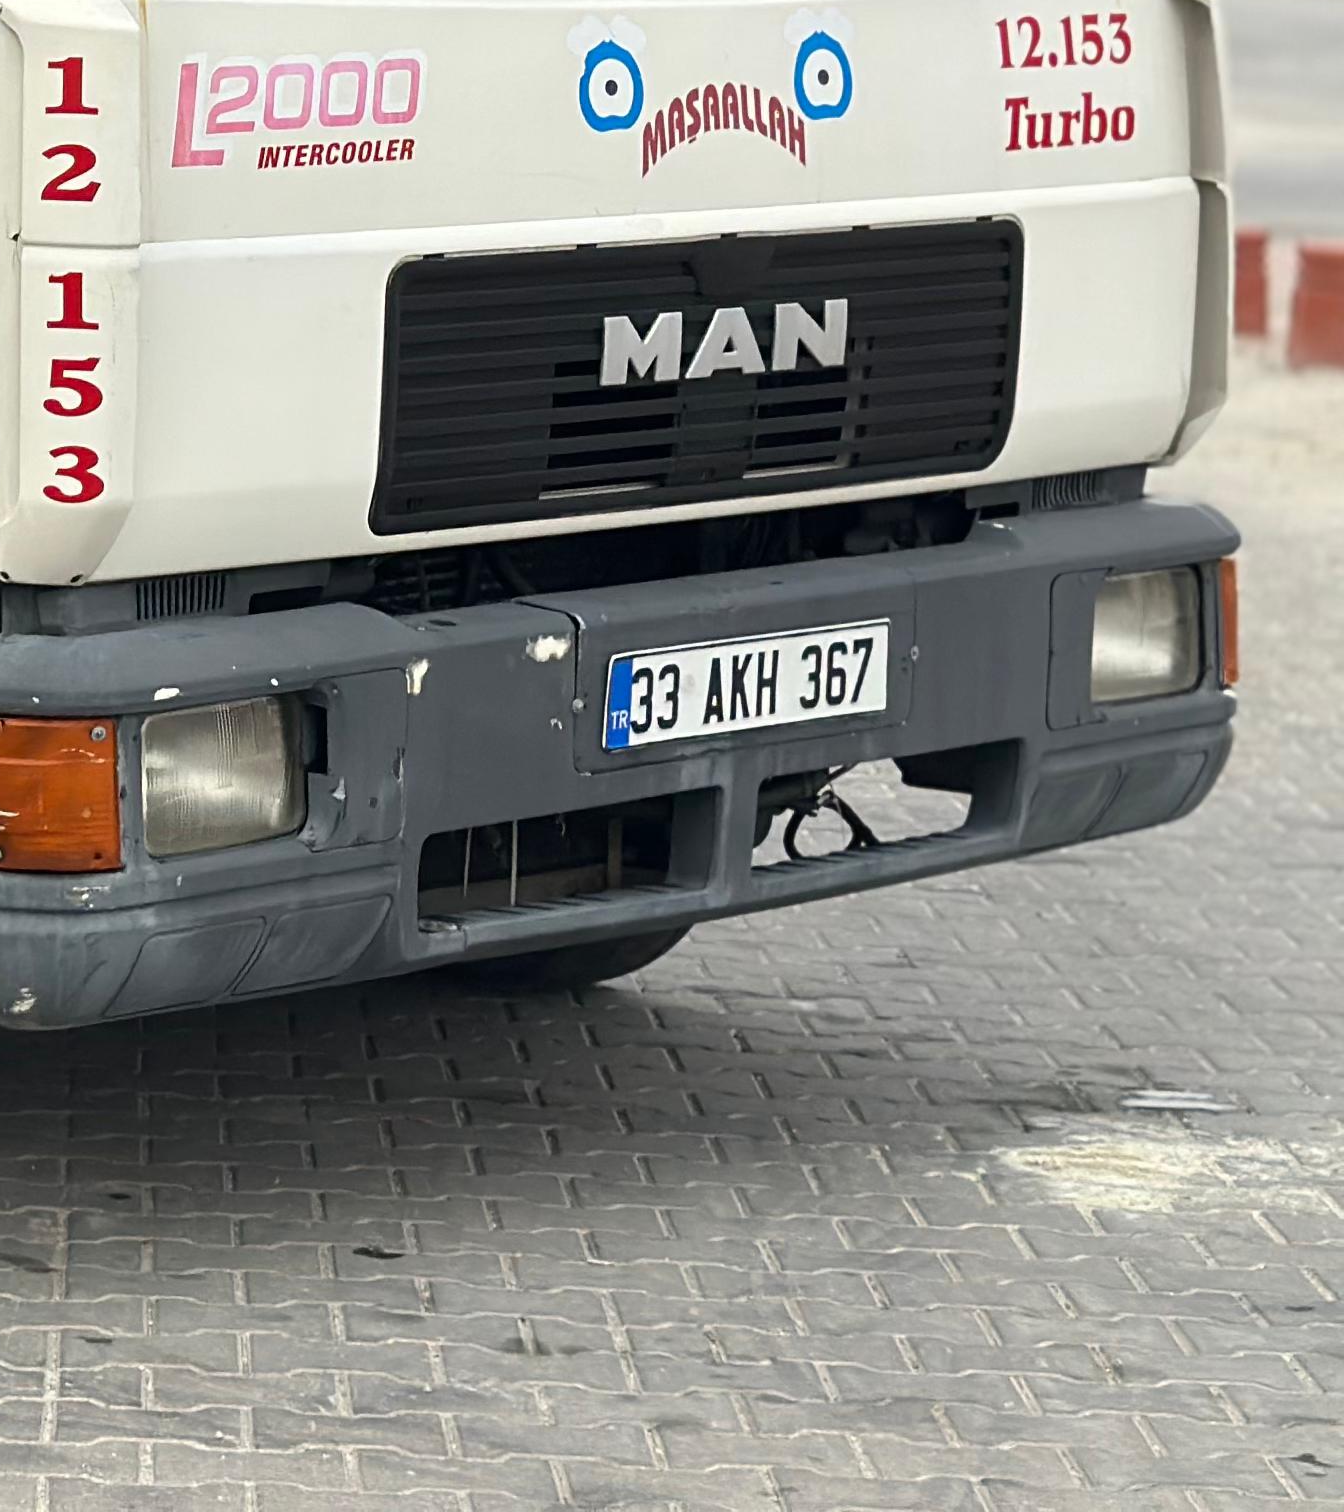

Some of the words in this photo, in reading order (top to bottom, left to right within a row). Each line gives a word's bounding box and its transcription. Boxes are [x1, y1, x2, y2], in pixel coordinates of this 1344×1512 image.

[995, 12, 1133, 71] 12.153
[171, 57, 422, 168] L2000
[1005, 91, 1136, 152] Turbo
[257, 138, 415, 170] INTERCOOLER
[599, 297, 849, 387] MAN
[631, 663, 682, 735] 33
[703, 648, 780, 725] AKH
[799, 636, 875, 711] 367
[612, 709, 631, 731] TR
